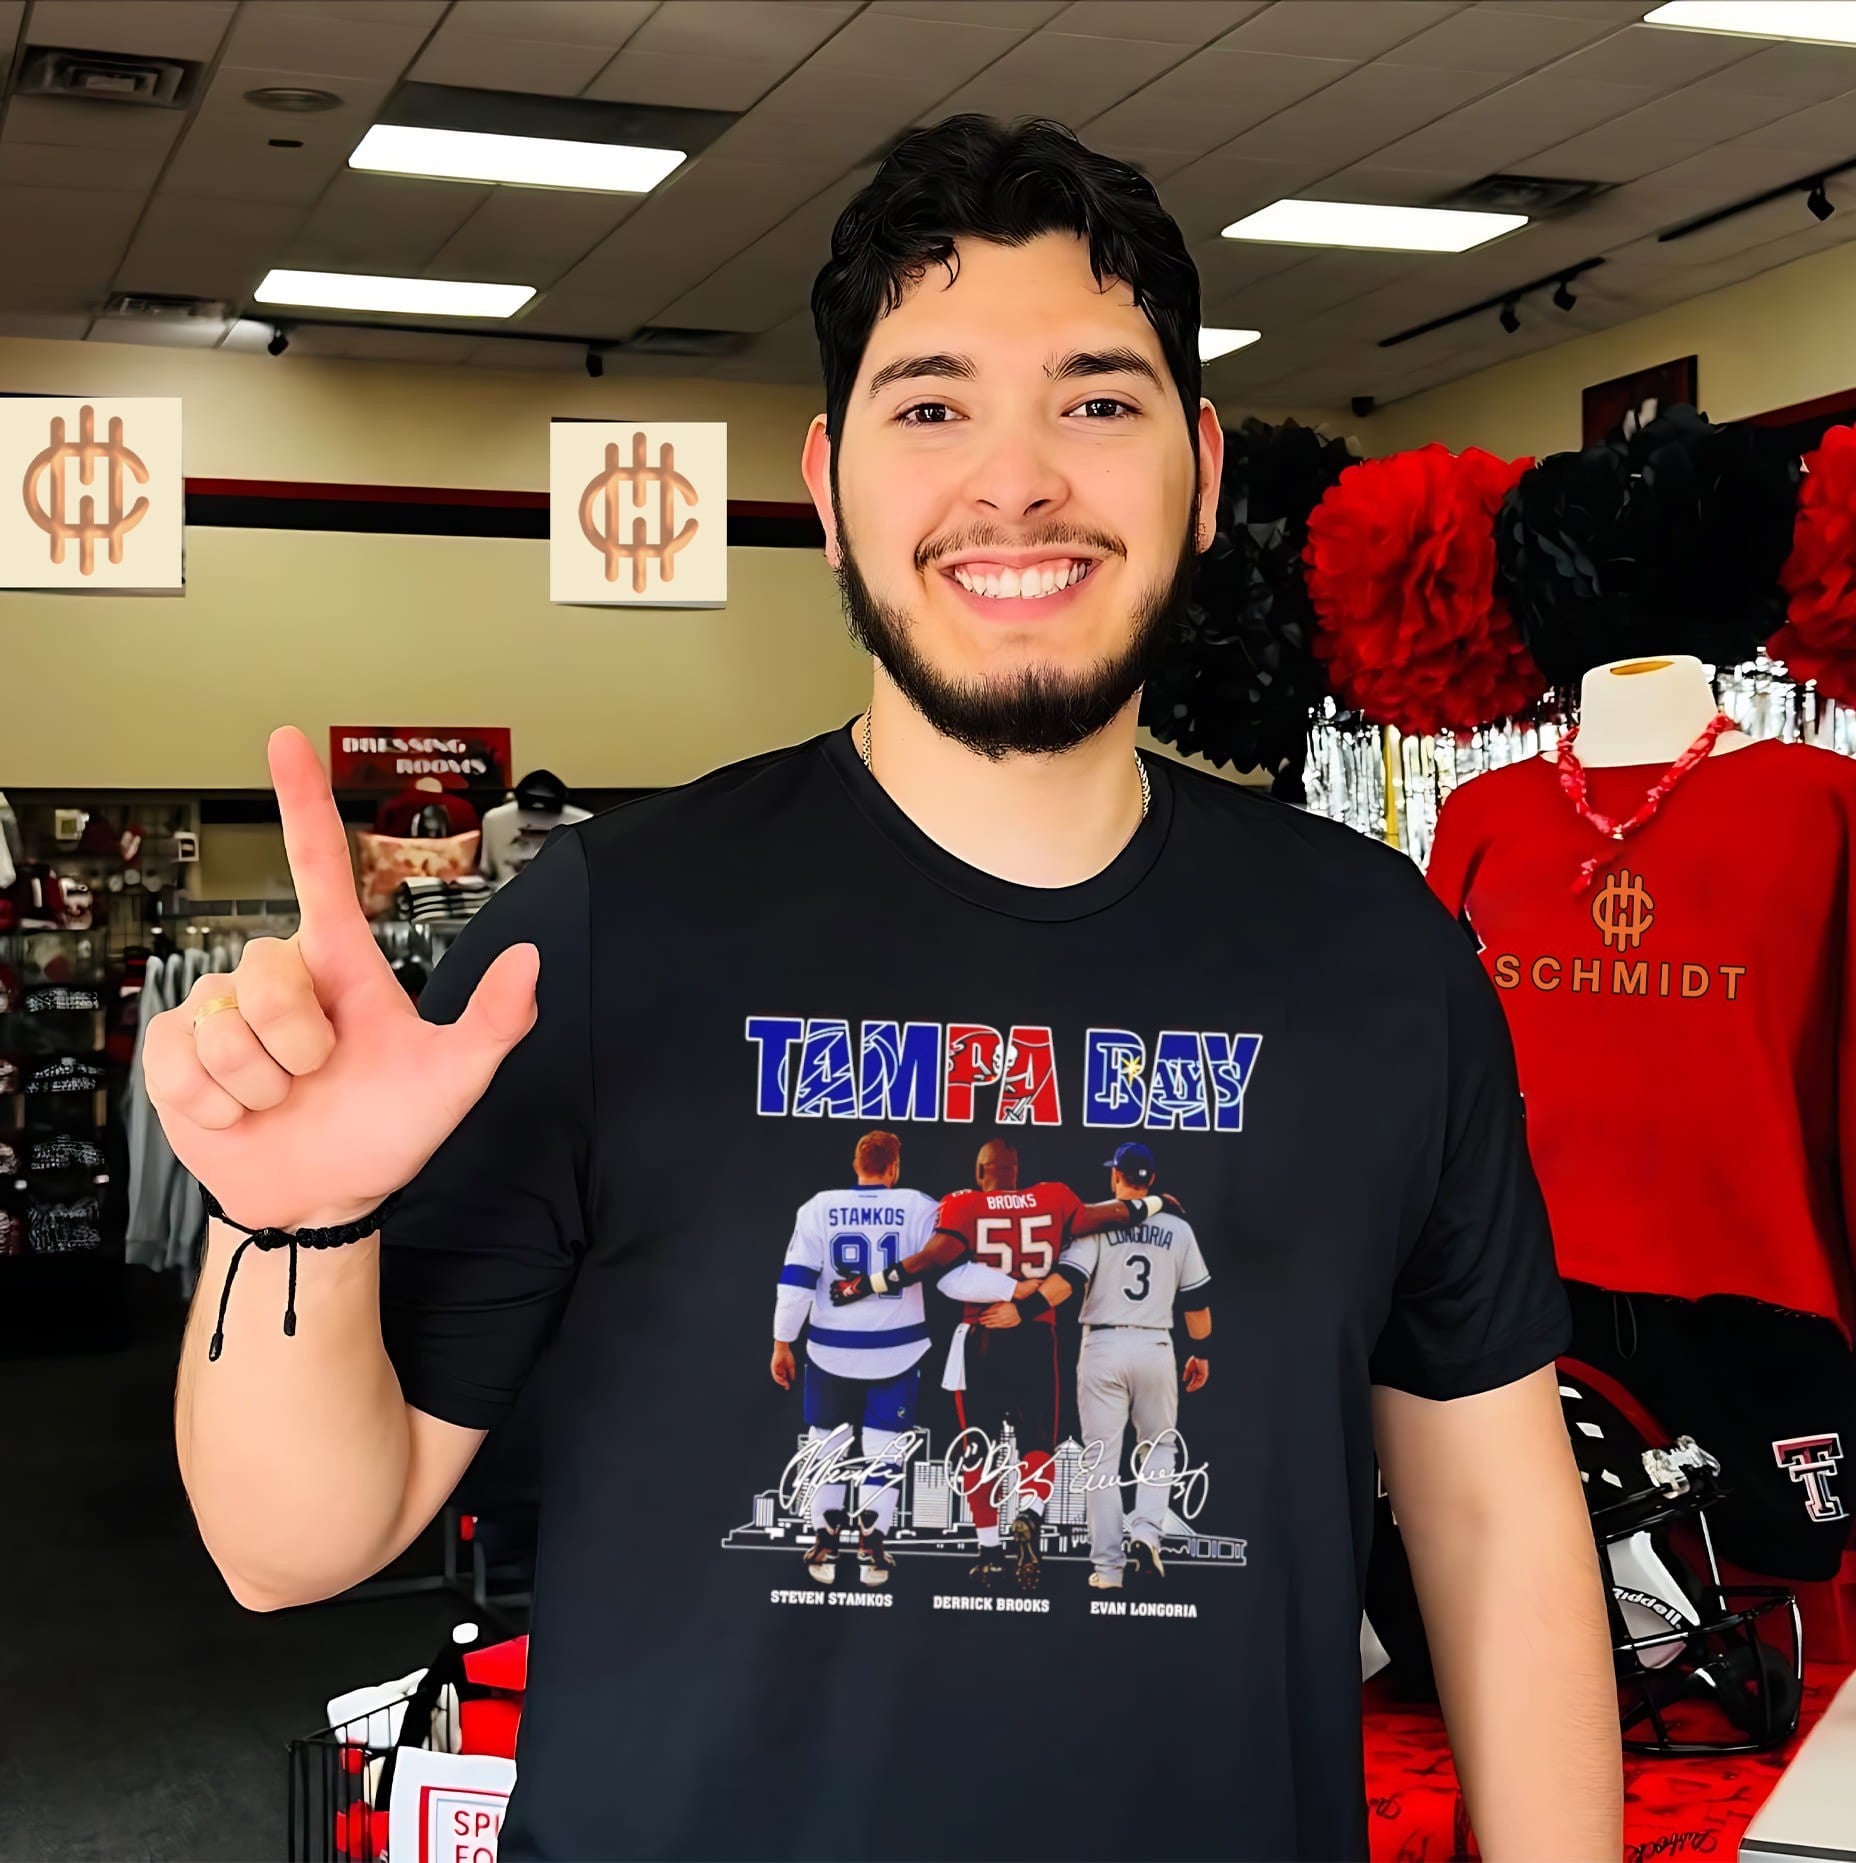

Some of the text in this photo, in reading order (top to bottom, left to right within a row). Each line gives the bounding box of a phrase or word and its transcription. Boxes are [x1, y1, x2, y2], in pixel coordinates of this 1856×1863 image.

[396, 758, 487, 775] ROOMS
[1494, 953, 1747, 1001] SCHMIDT
[745, 1016, 1264, 1132] TAMPA BAY
[986, 1193, 1037, 1210] BROOKS
[829, 1207, 905, 1227] STAMKOS
[976, 1213, 1054, 1279] 55
[830, 1232, 904, 1299] 91
[1123, 1253, 1152, 1301] 3
[770, 1589, 894, 1607] STEVEN STAMKOS
[932, 1595, 1050, 1613] DERRICK BROOKS
[1090, 1601, 1198, 1618] EVAN LONGORIA
